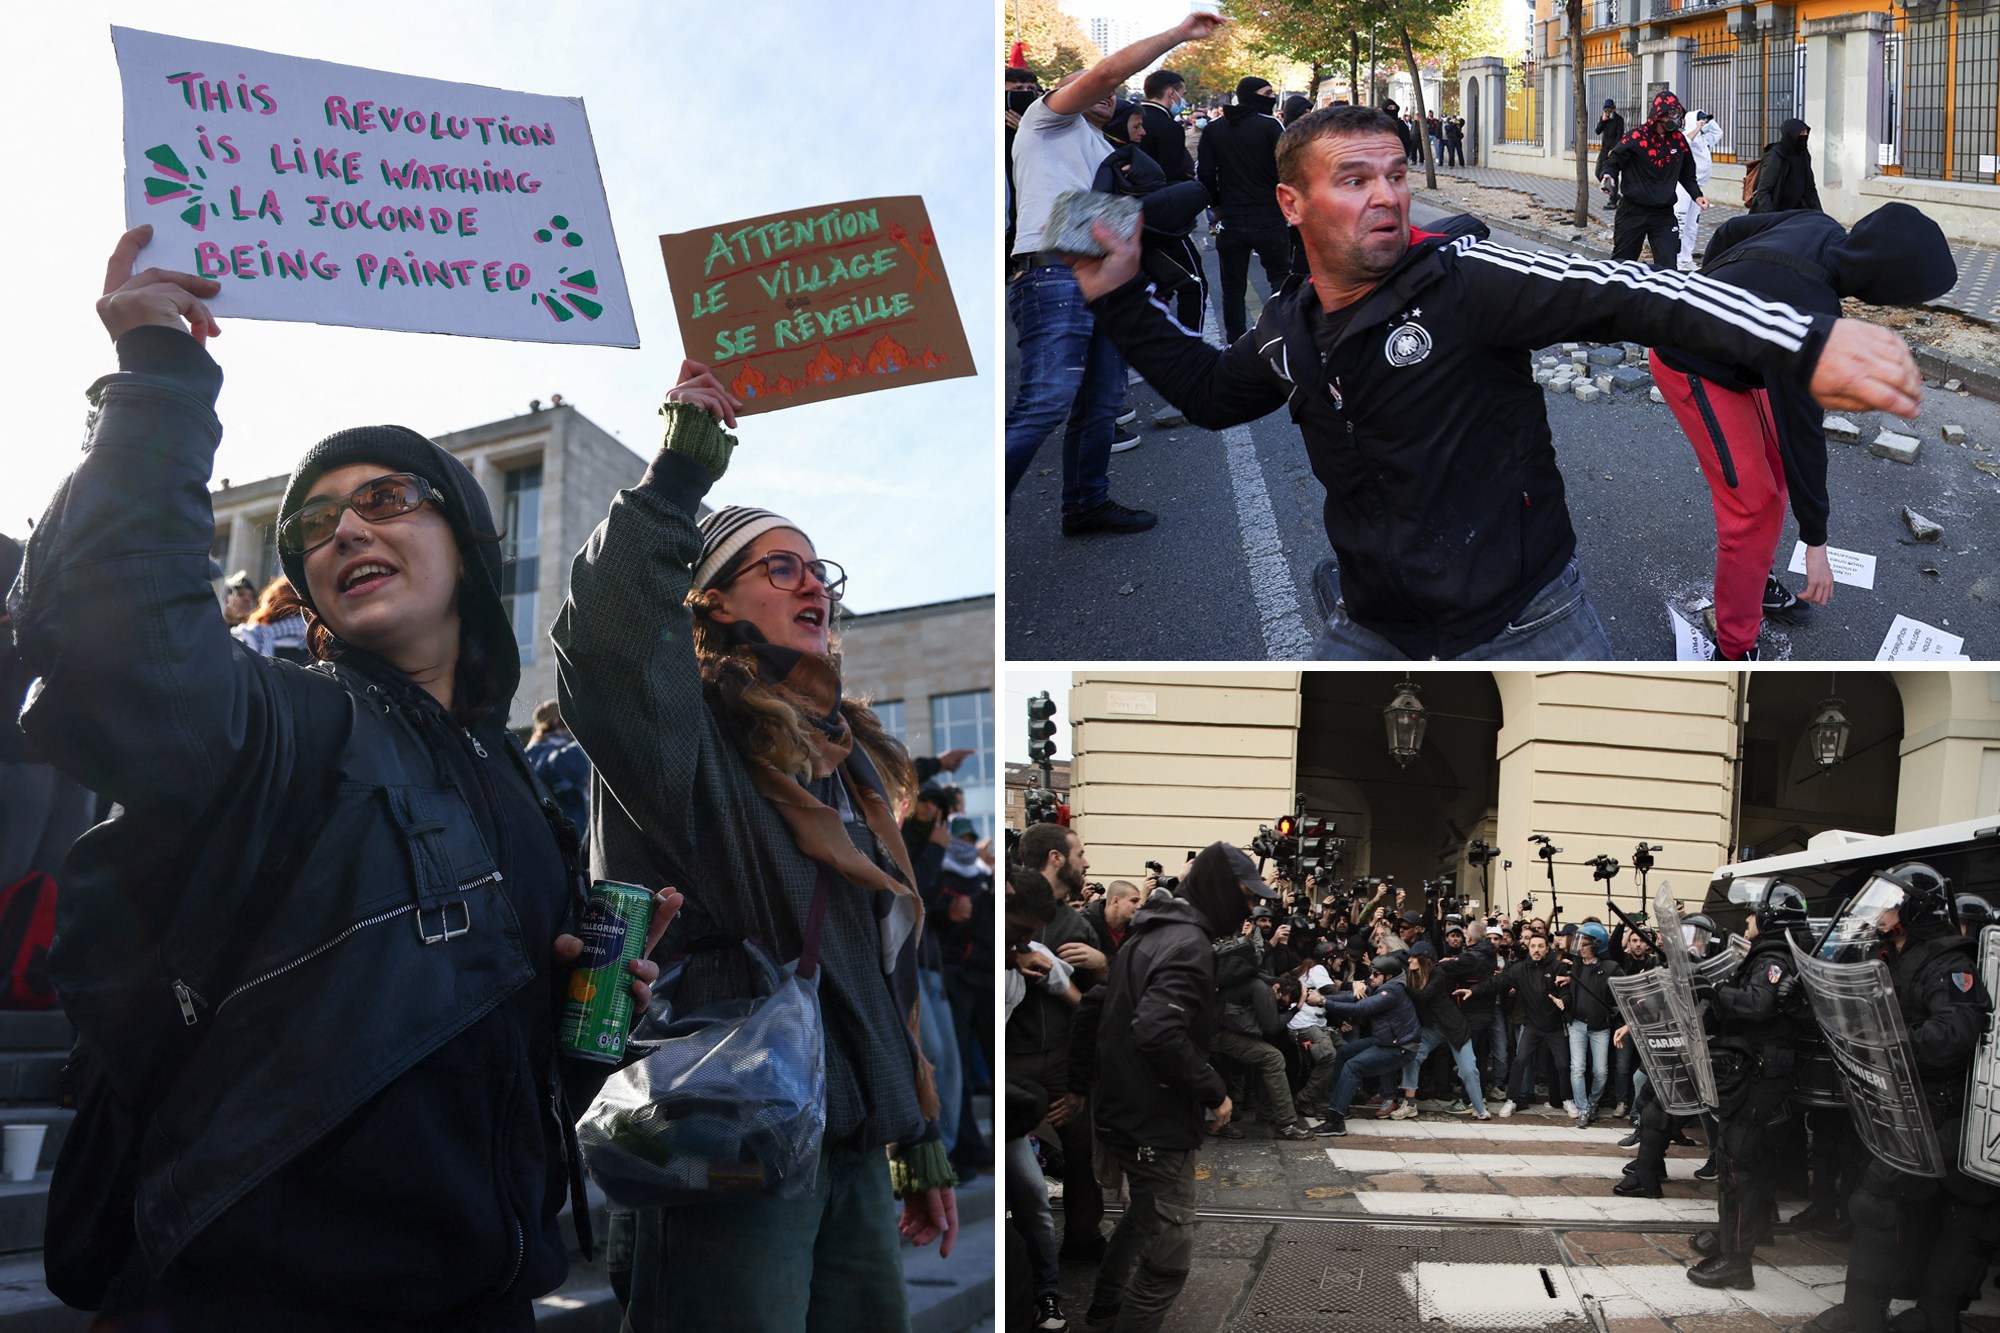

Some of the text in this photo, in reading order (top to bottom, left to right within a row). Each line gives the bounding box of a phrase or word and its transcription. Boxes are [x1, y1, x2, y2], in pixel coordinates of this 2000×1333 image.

[167, 71, 555, 148] THIS REVOLUTION
[197, 126, 542, 195] IS LIKE WATCHING
[230, 185, 479, 238] LA JOCONDE
[704, 208, 879, 276] ATTENTION
[194, 240, 531, 293] BEING PAINTED
[692, 247, 897, 319] LE VILLAGE
[714, 325, 756, 360] SE
